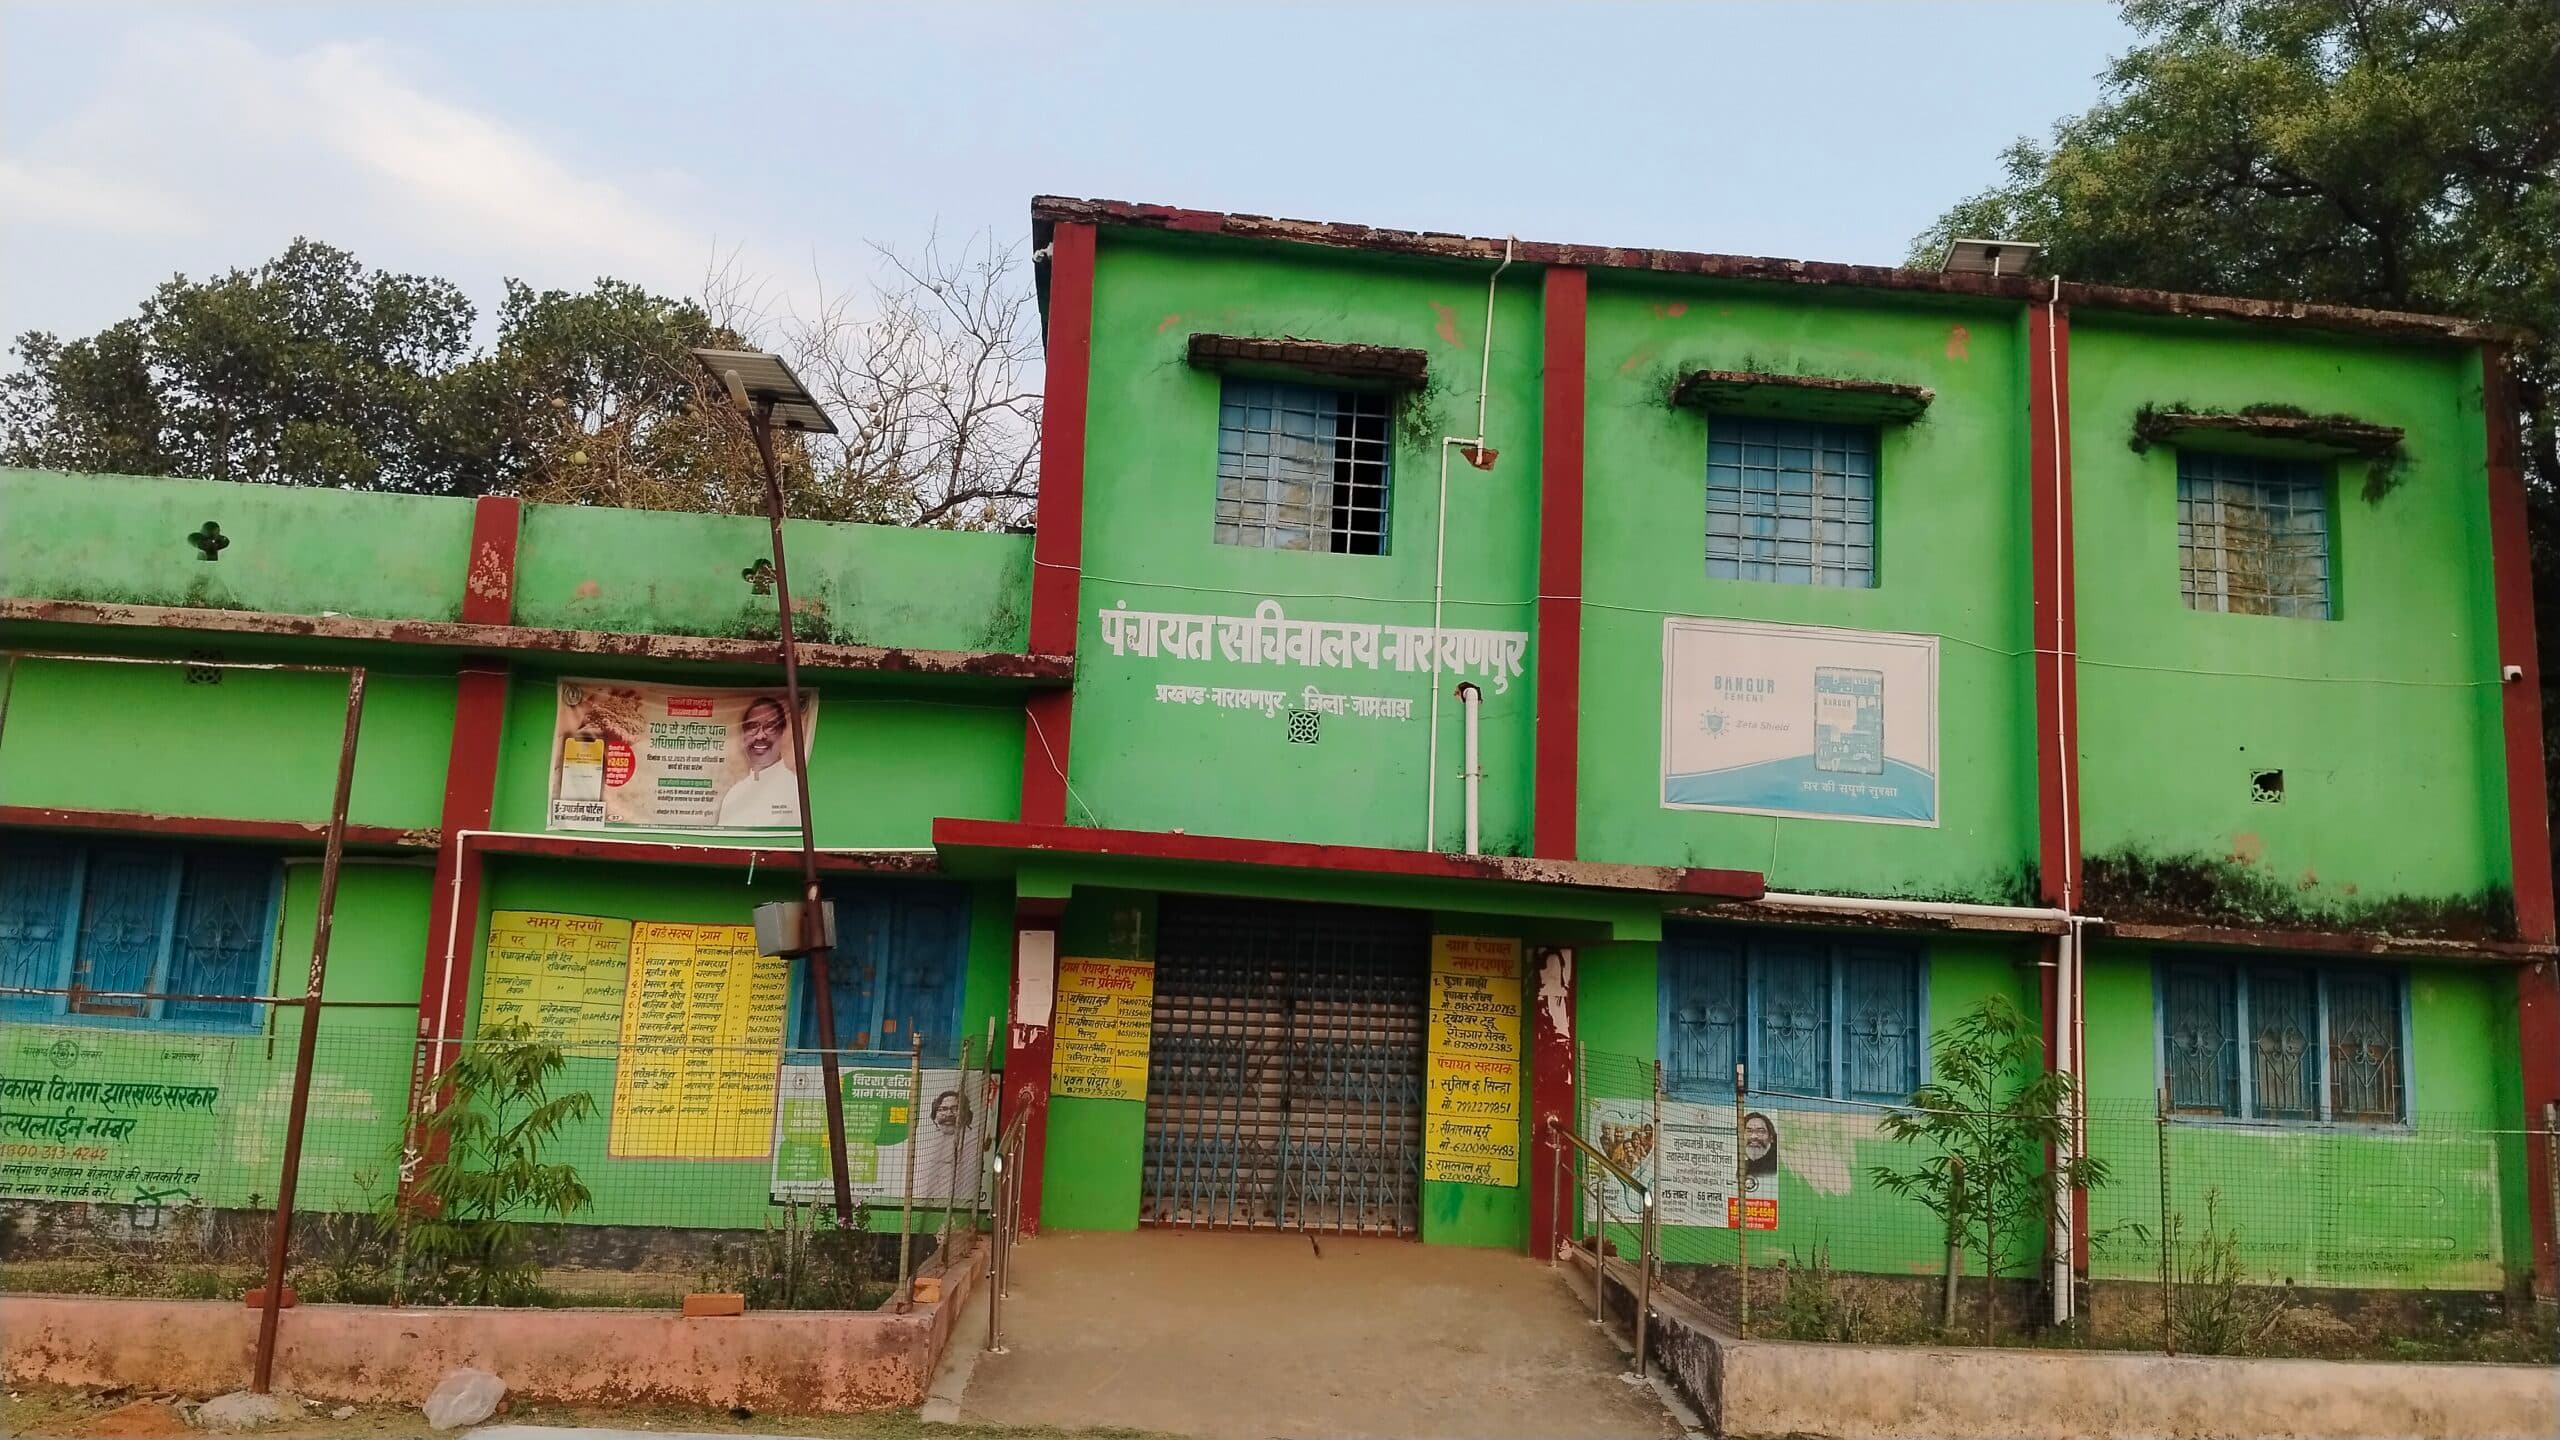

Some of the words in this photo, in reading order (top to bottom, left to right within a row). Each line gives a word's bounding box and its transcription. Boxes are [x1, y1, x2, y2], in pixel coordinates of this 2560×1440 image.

[1099, 599, 1217, 660] पंचायत
[1217, 599, 1381, 670] सचिवालय
[1383, 625, 1529, 694] नारायणपुर
[1714, 675, 1776, 694] BANGUR
[650, 723, 667, 734] 700
[670, 721, 679, 735] से
[680, 721, 707, 735] अधिक
[709, 725, 727, 736] धान
[713, 740, 725, 751] पर
[1803, 780, 1818, 792] घर
[1822, 780, 1836, 794] की
[1867, 784, 1897, 800] सुरक्षा
[527, 917, 560, 929] समय
[511, 935, 527, 946] पद
[556, 935, 576, 946] दिन
[668, 928, 694, 942] सदस्य
[736, 931, 749, 943] पद
[1443, 976, 1463, 989] पूजा
[1437, 1055, 1472, 1072] पंचायत
[1474, 1060, 1513, 1075] सहायक
[852, 1073, 885, 1088] बिरसा
[1484, 1075, 1512, 1096] सिन्हा
[48, 1074, 103, 1104] विभाग
[100, 1083, 165, 1115] झारखण्ड
[163, 1085, 220, 1118] सरकार
[851, 1087, 875, 1100] ग्राम
[875, 1085, 911, 1100] योजना
[0, 1106, 88, 1144] ल्पलाईन
[86, 1116, 139, 1145] नम्बर
[125, 1166, 140, 1182] की
[45, 1184, 57, 1197] पर
[60, 1181, 91, 1198] संपर्क
[1673, 1189, 1688, 1200] लाख
